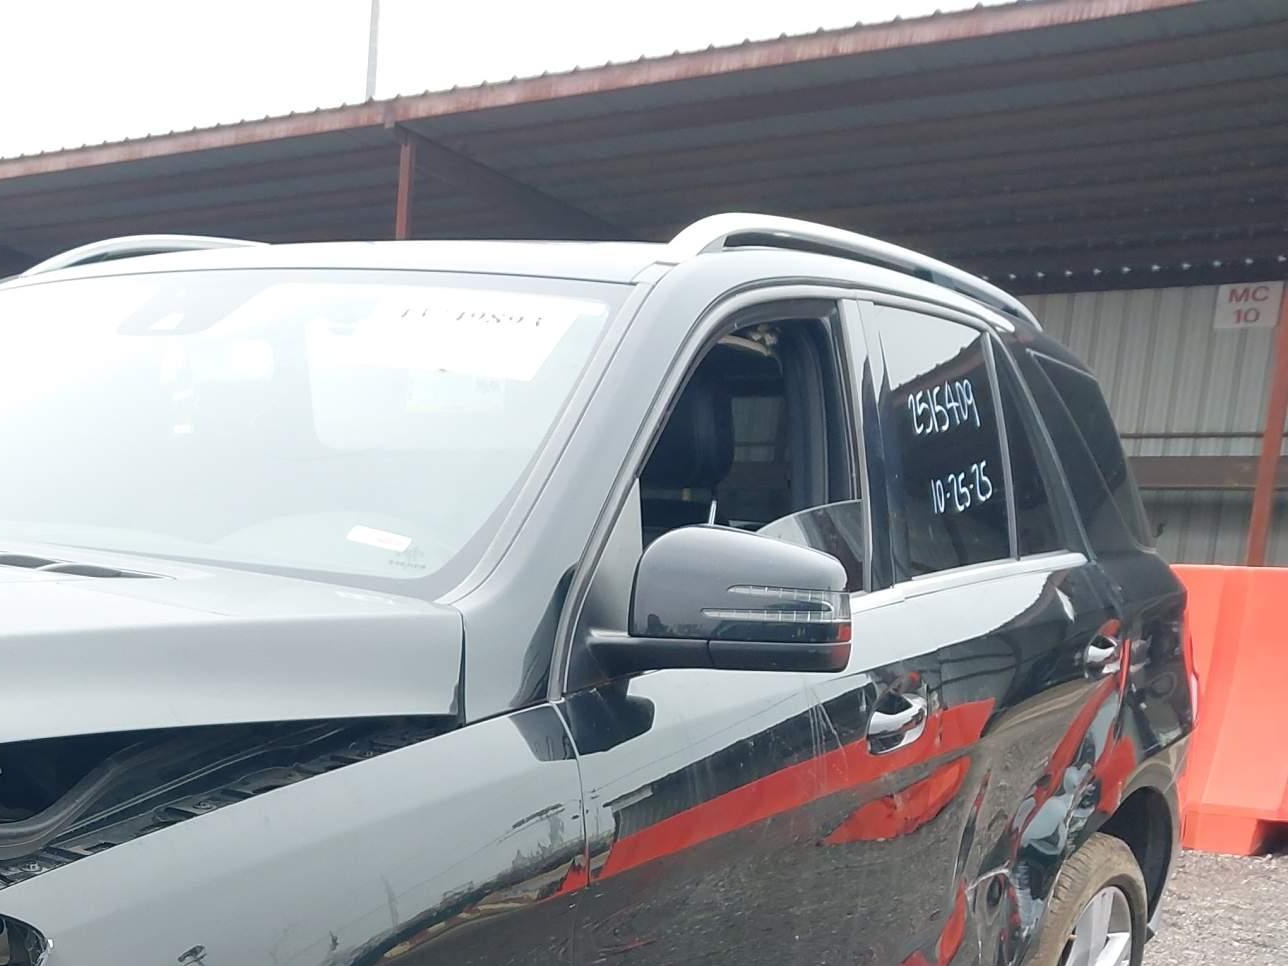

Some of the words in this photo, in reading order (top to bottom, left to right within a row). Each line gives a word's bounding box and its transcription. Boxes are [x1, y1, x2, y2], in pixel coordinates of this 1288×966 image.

[1228, 285, 1270, 304] MC
[1232, 307, 1260, 324] 10
[908, 378, 981, 434] 2515409
[930, 460, 993, 515] 10-25-25
